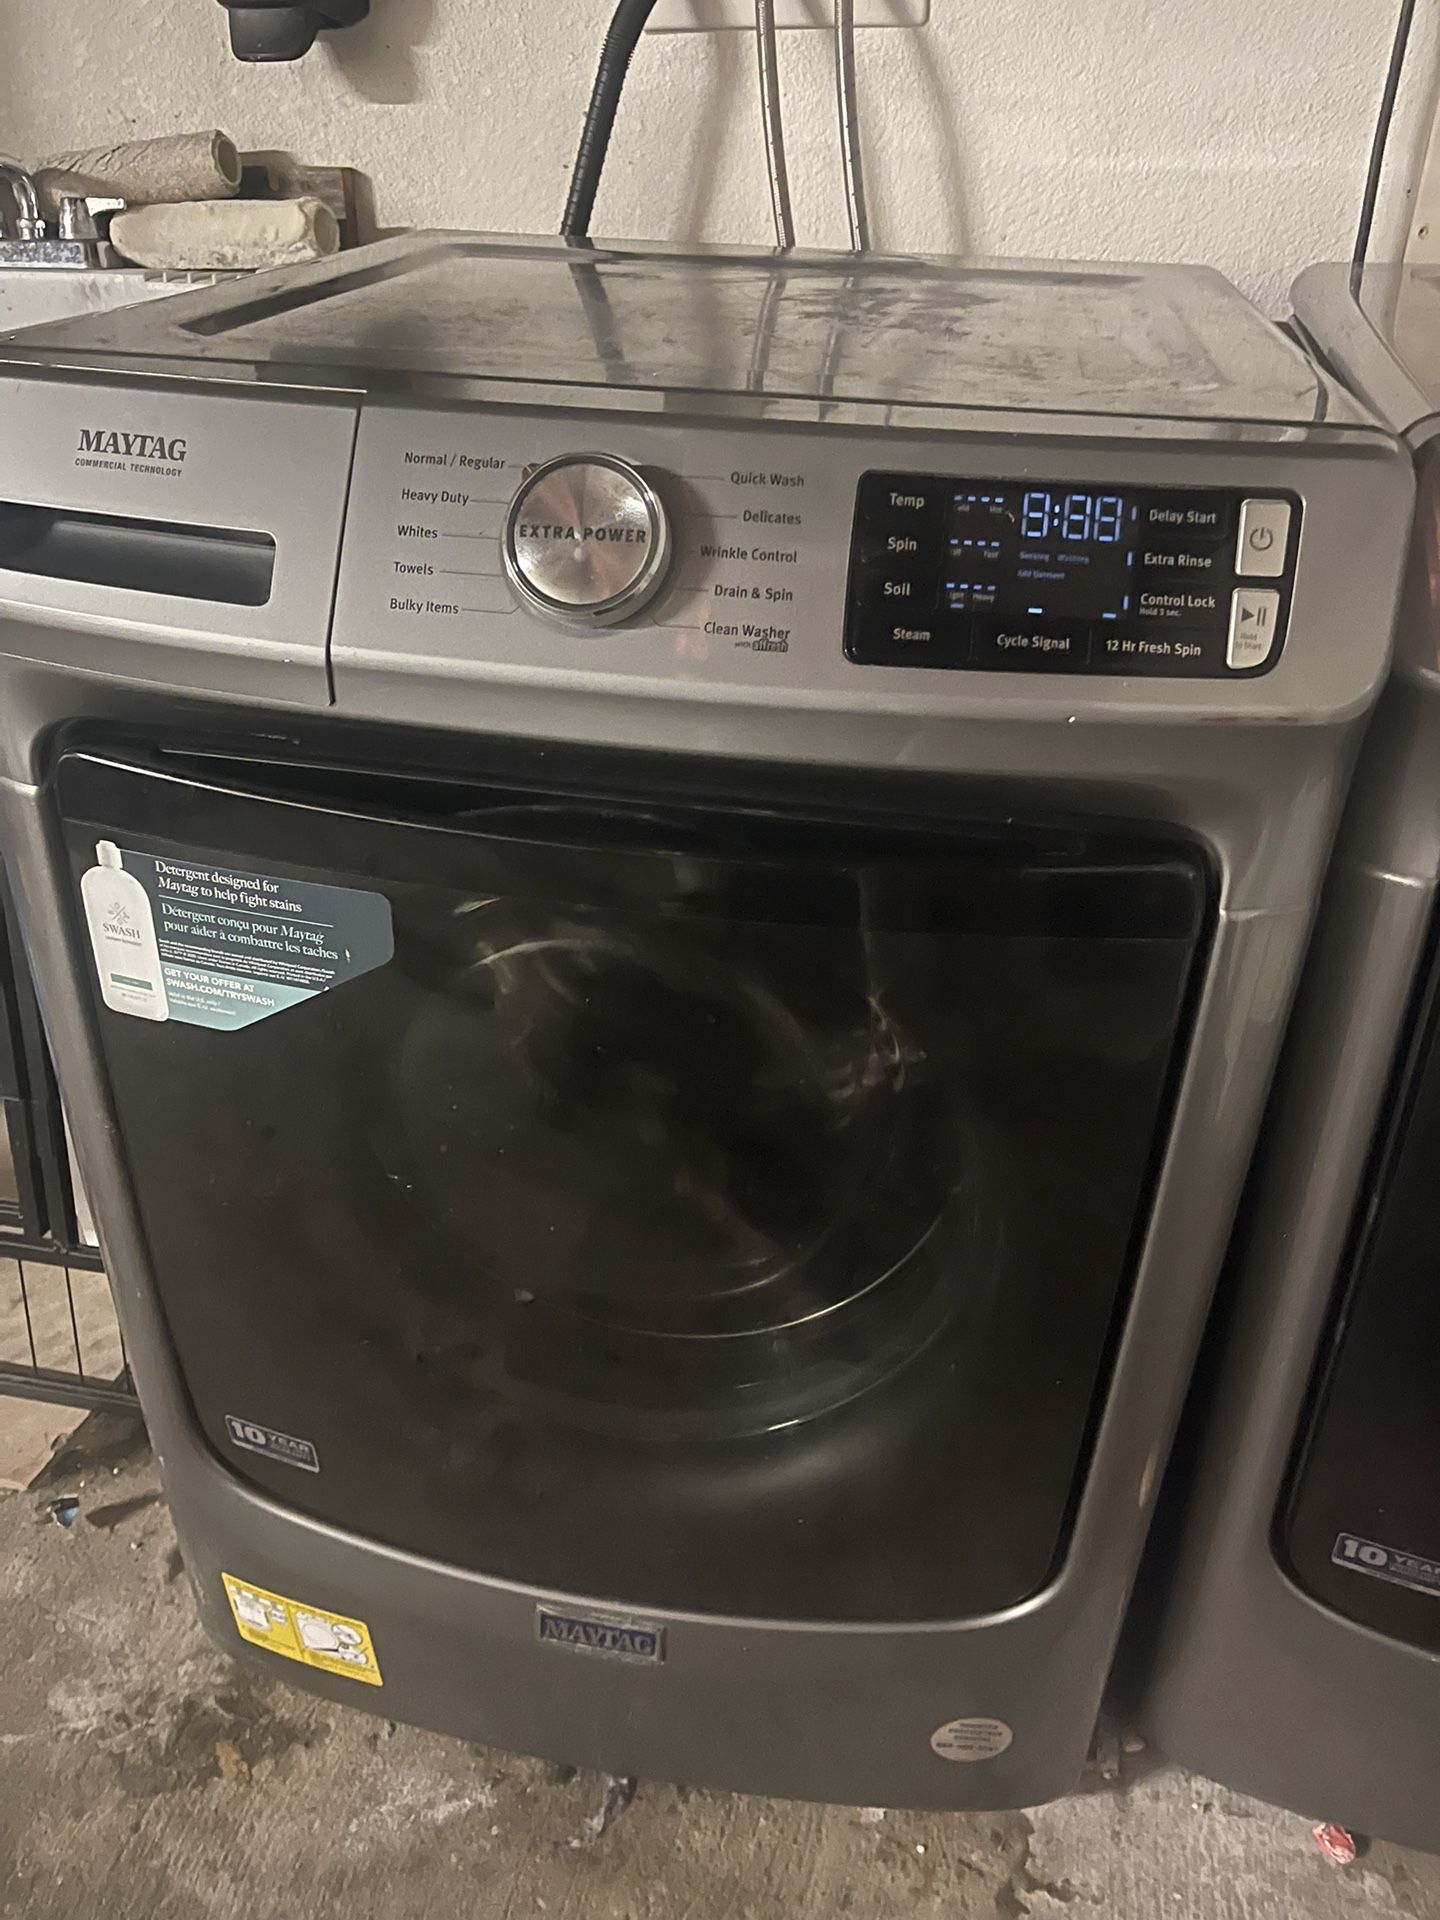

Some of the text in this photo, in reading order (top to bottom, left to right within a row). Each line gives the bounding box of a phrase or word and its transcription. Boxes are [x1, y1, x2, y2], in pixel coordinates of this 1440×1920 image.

[77, 429, 187, 462] MAYTAG
[75, 458, 183, 477] COMMERCIAL TECHNOLOGY
[404, 452, 447, 466] Normal
[459, 455, 506, 471] Regular
[730, 471, 805, 487] Quick Wash
[401, 488, 470, 506] Heavy Duty
[889, 493, 925, 510] Temp
[742, 510, 802, 525] Delicates
[1149, 509, 1217, 525] Delay Start
[397, 525, 438, 539] Whites
[518, 524, 647, 544] EXTRA POWER
[887, 536, 918, 553] Spin
[700, 545, 798, 563] Wrinkle Control
[1144, 552, 1212, 568] Extra Rinse
[393, 561, 434, 575] Towels
[714, 584, 793, 603] Drain & Spin
[883, 582, 911, 596] Soil
[389, 598, 459, 614] Bulky Items
[1140, 593, 1216, 608] Control Lock
[704, 621, 791, 639] Clean Washer
[893, 628, 931, 641] Steam
[996, 634, 1071, 651] Cycle Signal
[1105, 640, 1201, 658] 12 Hr Fresh Spin
[155, 860, 279, 893] Detergent designed for
[158, 876, 303, 913] Maytag to help fight stains
[103, 922, 141, 939] SWASH
[161, 903, 325, 945] Détergent conçu pour Maytag
[163, 920, 339, 960] pour aider à combattre les taches
[163, 967, 255, 993] GET YOUR OFFER AT
[165, 978, 275, 1008] SWASH.COM/TRYSWASH
[231, 1420, 266, 1446] 10
[1343, 1539, 1388, 1567] 10
[544, 1618, 653, 1656] MAYTAG
